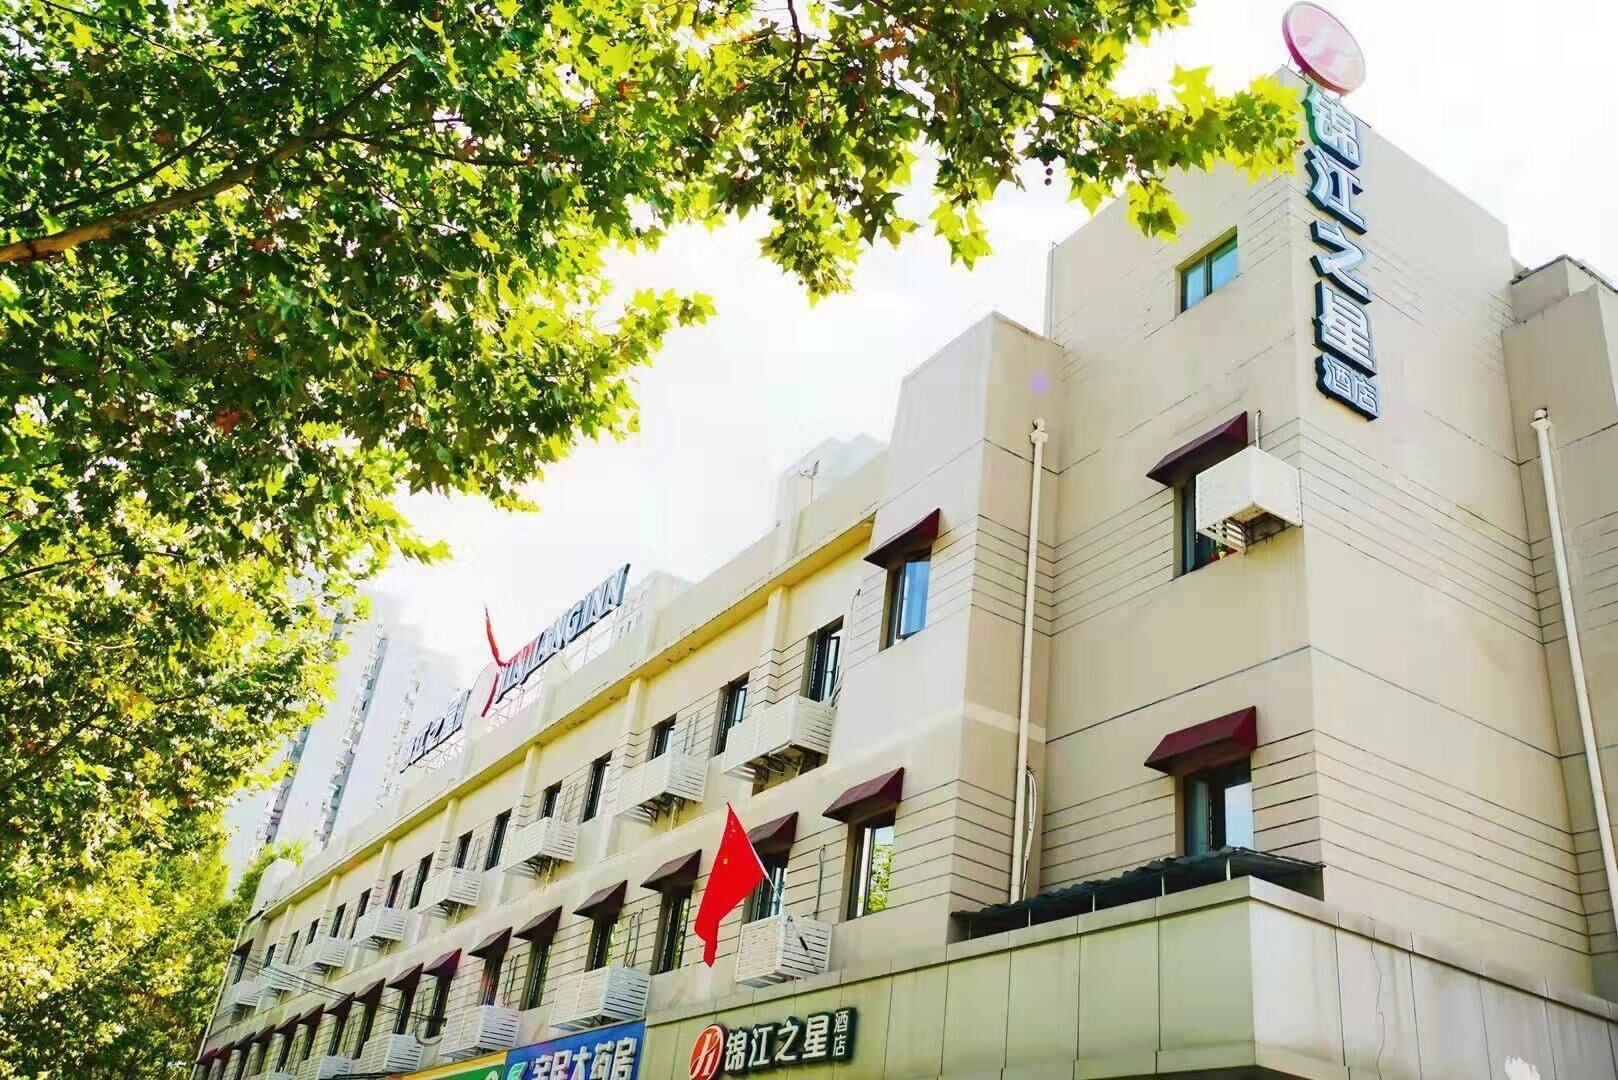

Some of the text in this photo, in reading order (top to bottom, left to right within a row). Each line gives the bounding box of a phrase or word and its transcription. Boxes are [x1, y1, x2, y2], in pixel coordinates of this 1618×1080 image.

[1320, 355, 1379, 419] 酒店
[724, 1014, 829, 1072] 锦江之星
[832, 1010, 849, 1057] 酒店
